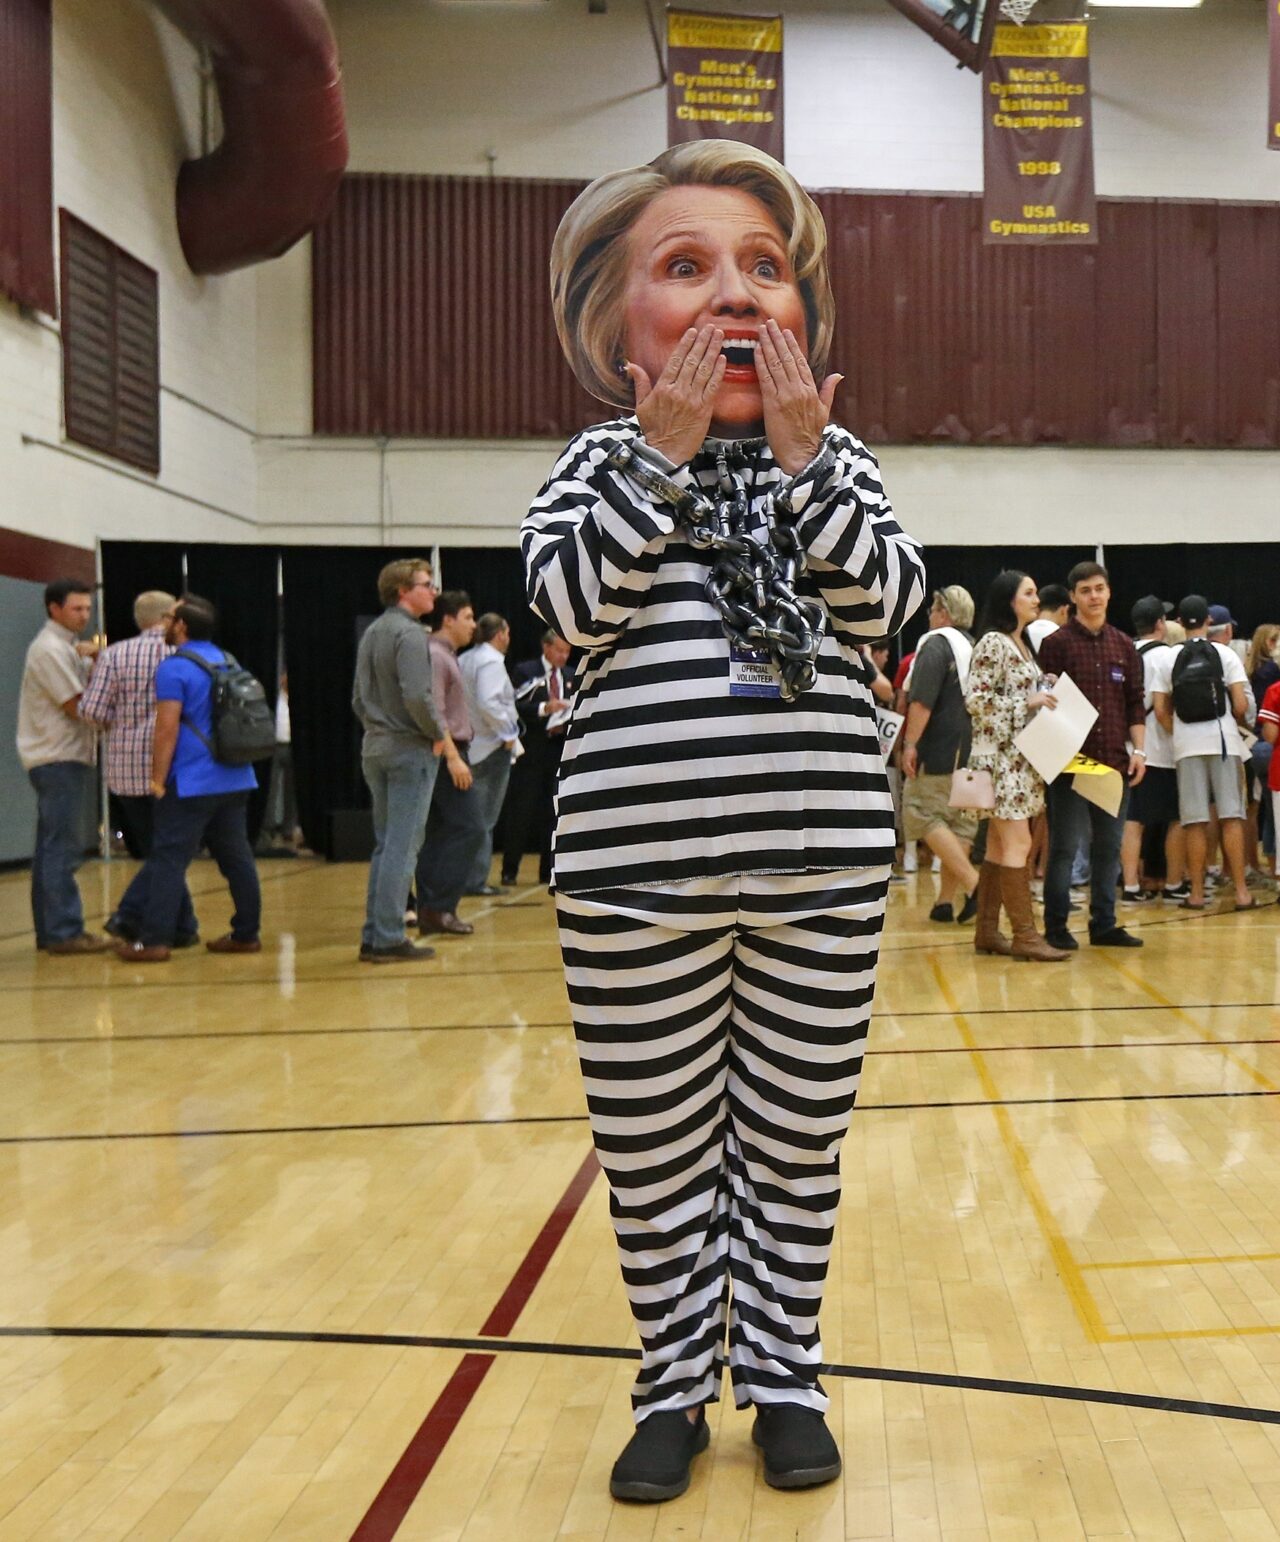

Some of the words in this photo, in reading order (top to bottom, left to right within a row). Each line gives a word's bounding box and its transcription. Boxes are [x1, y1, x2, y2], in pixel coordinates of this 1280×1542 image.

[700, 60, 757, 76] Men's
[1008, 68, 1060, 82] Men's
[674, 72, 776, 90] Gymnastics
[684, 89, 760, 105] National
[989, 82, 1086, 98] Gymnastics
[999, 97, 1069, 112] National
[676, 105, 774, 124] Champions
[993, 113, 1083, 129] Champions
[1022, 205, 1056, 218] USA
[990, 220, 1090, 236] Gymnastics
[741, 664, 769, 674] OFFICIAL
[737, 674, 774, 683] VOLUNTEER
